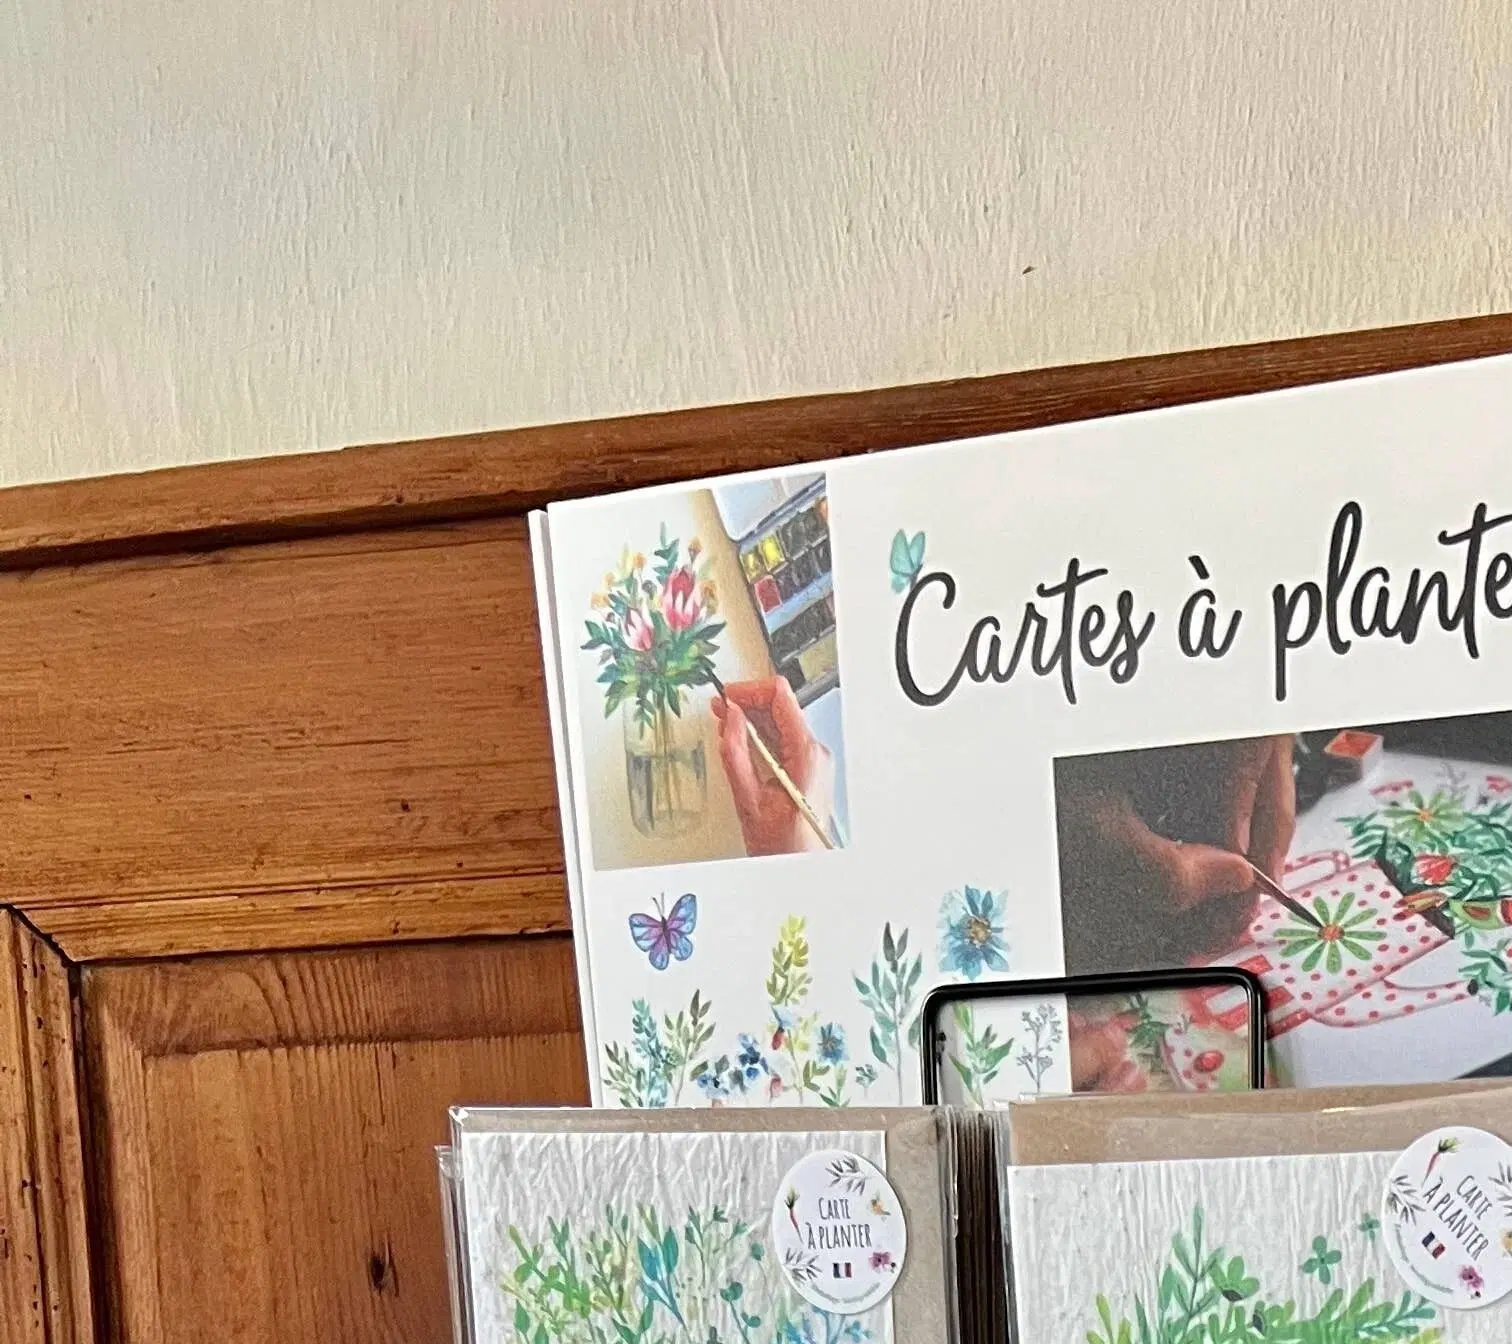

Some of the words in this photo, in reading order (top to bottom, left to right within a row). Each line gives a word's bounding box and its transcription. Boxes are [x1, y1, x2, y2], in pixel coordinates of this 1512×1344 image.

[894, 556, 1156, 707] Cartes
[1178, 555, 1243, 659] à
[817, 1196, 852, 1220] CARTE
[1422, 1176, 1444, 1204] À
[1456, 1174, 1494, 1221] CARTE
[805, 1221, 817, 1250] À
[818, 1223, 873, 1250] PLANTER
[1432, 1192, 1491, 1262] PLANTER
